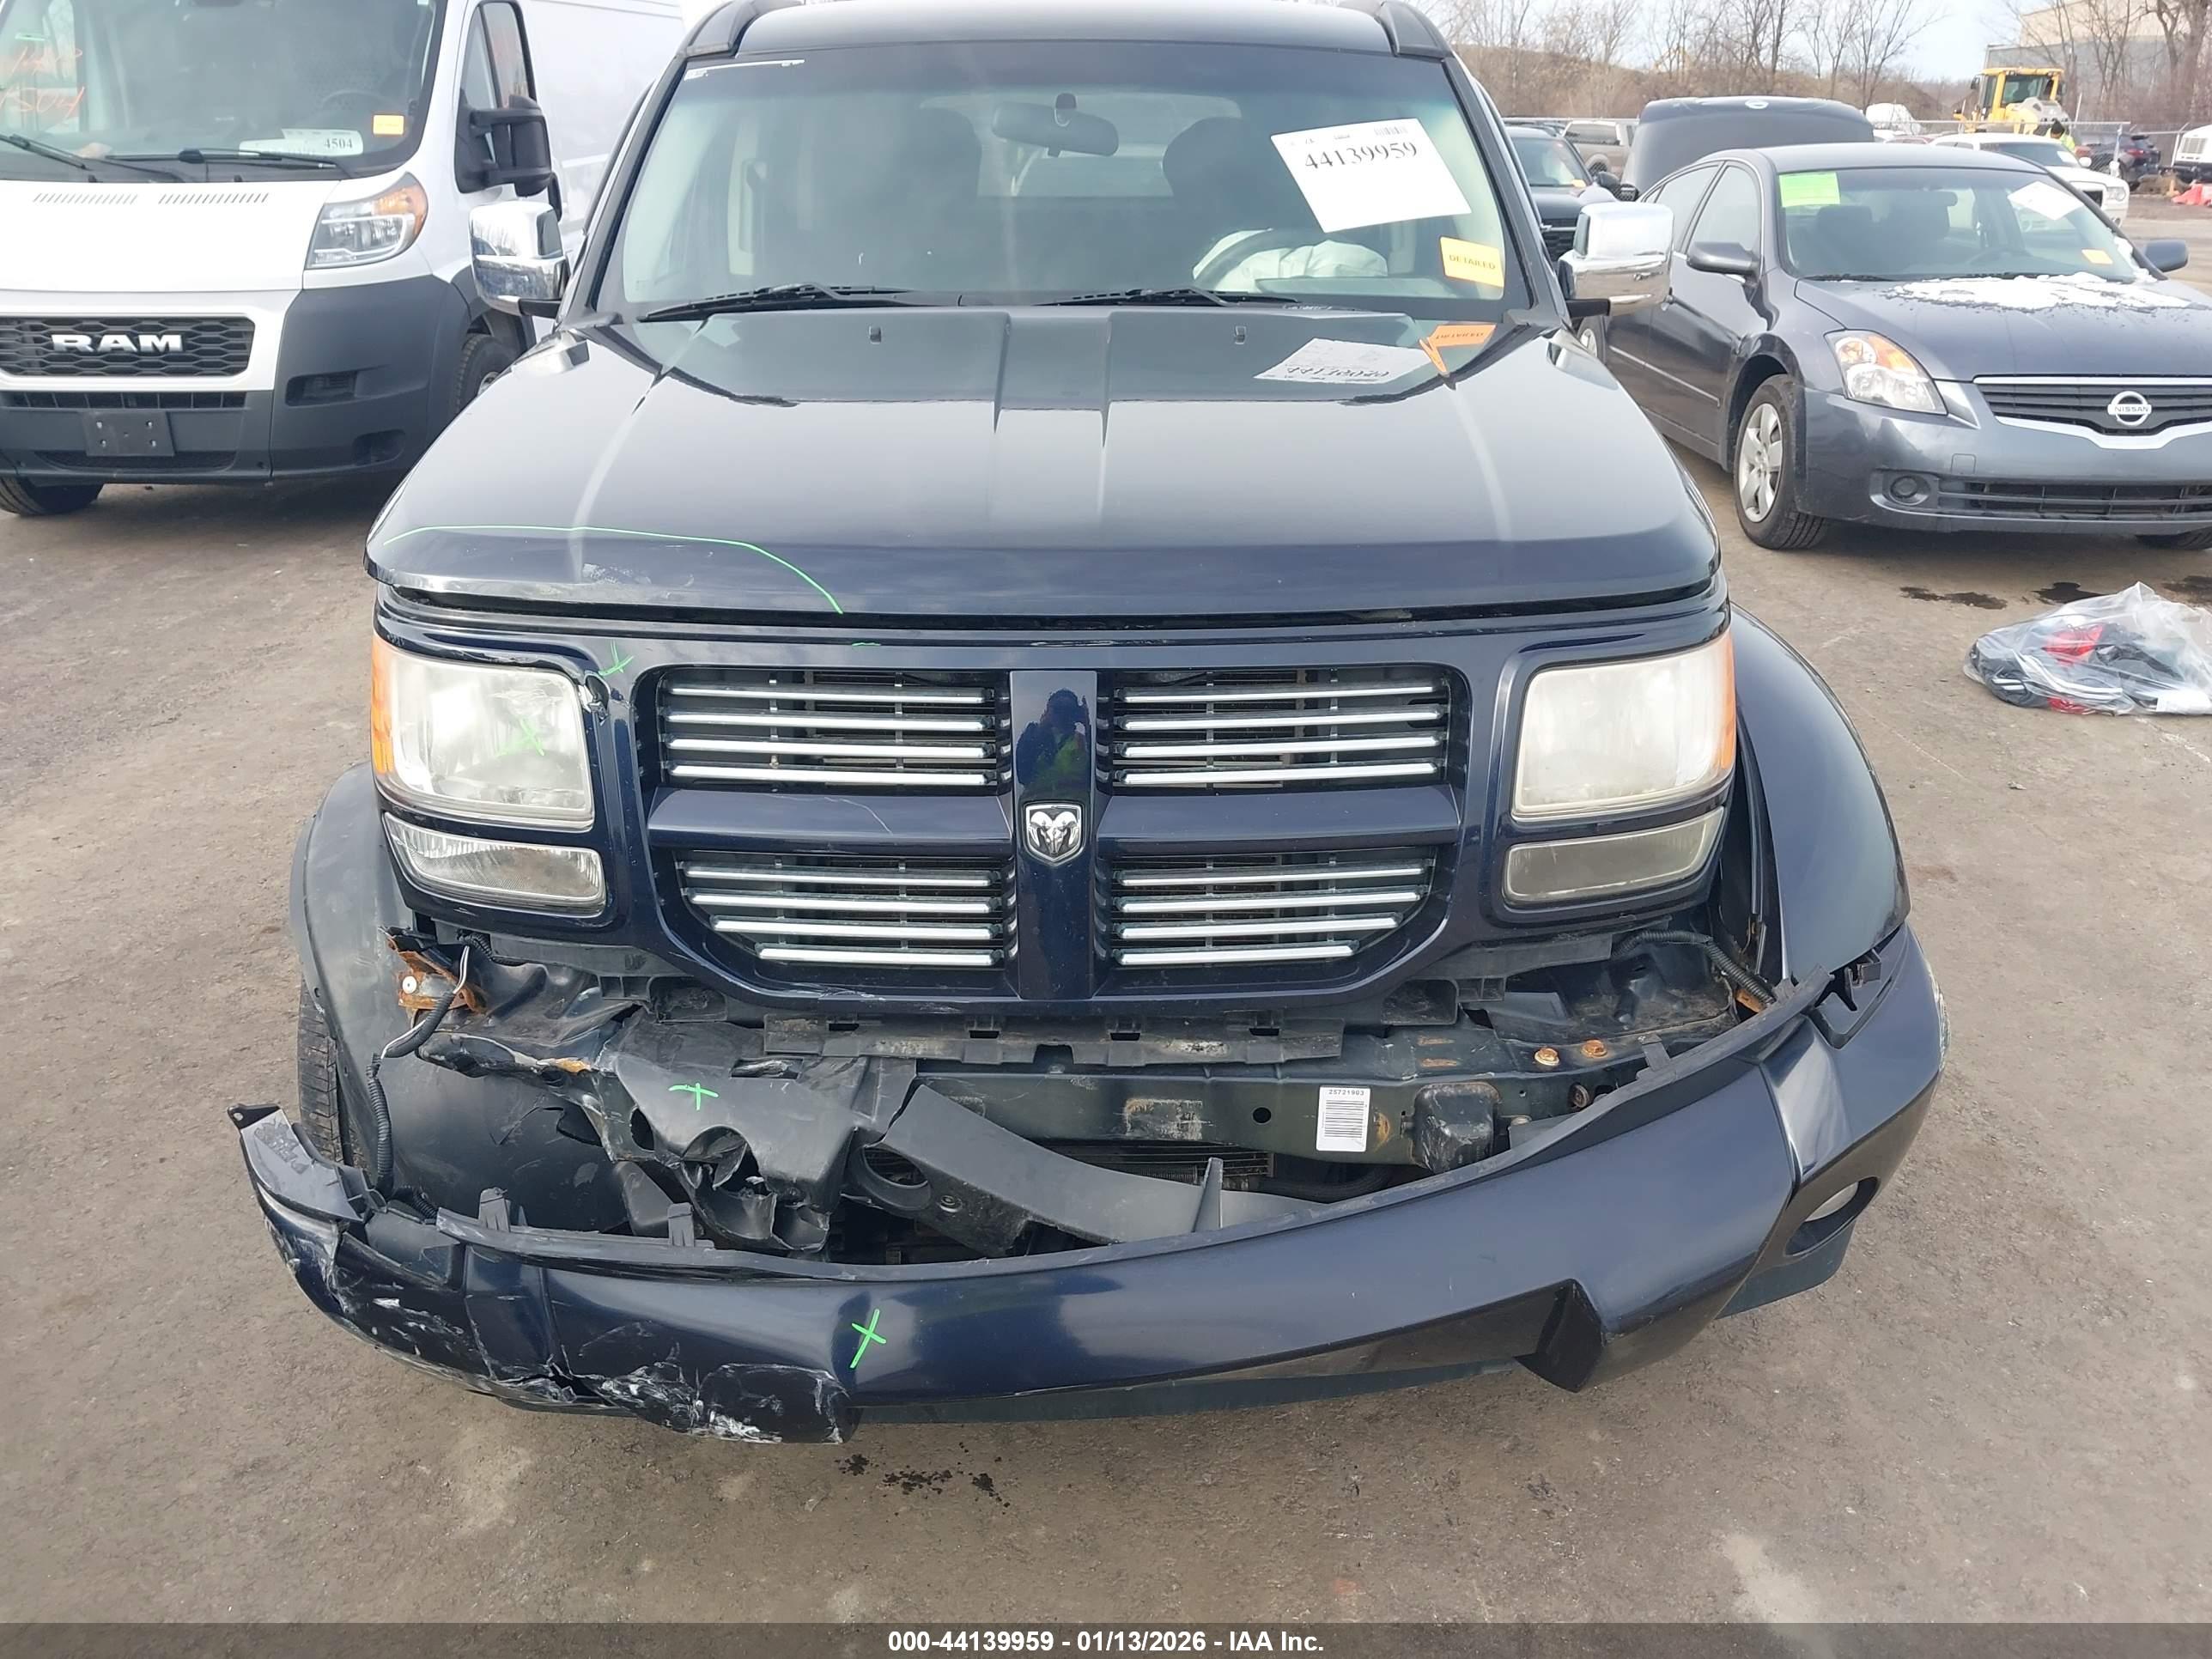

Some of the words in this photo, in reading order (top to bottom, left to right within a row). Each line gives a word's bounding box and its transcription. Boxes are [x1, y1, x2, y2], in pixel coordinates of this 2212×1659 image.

[324, 137, 353, 149] 4504
[1304, 142, 1417, 169] 44139959
[1449, 254, 1496, 270] DETAILED
[51, 334, 183, 353] RAM
